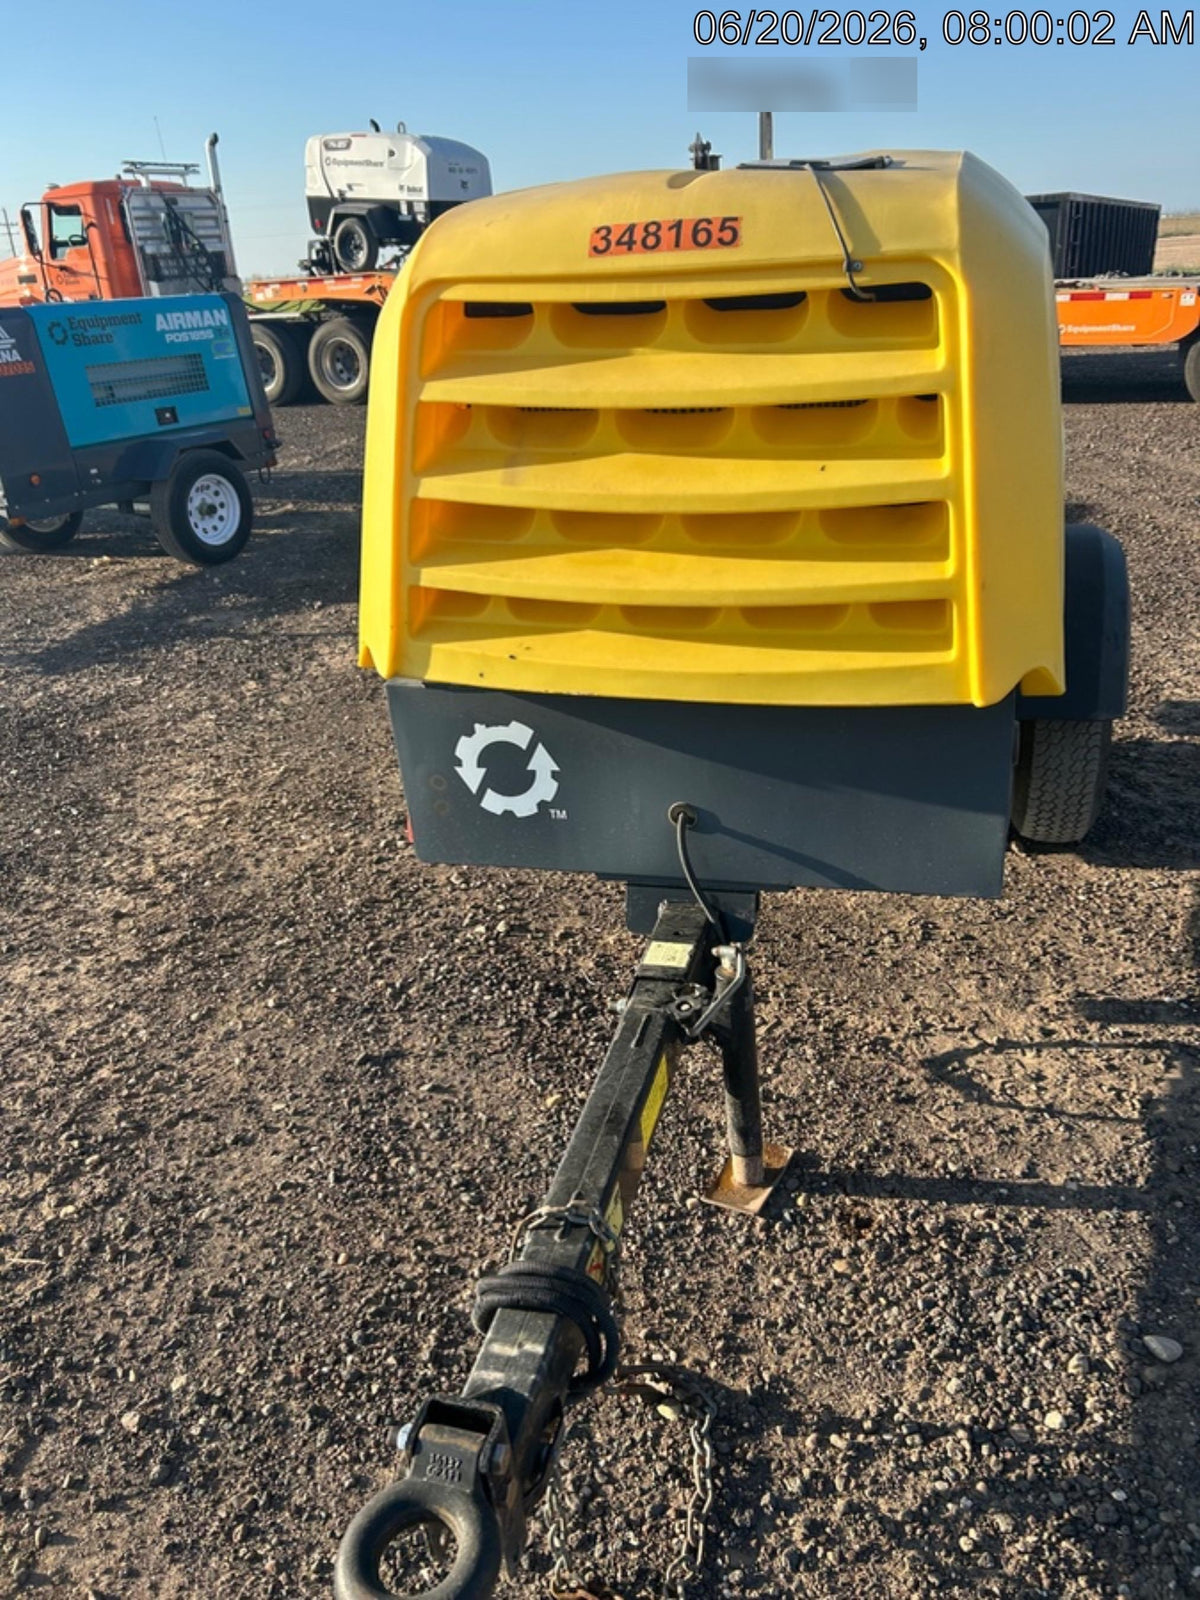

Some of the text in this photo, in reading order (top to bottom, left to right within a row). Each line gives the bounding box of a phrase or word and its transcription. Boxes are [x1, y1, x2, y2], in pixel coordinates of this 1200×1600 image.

[592, 216, 739, 254] 348165
[67, 312, 143, 333] Equipment
[155, 309, 228, 332] AIRMAN
[72, 332, 114, 348] Share
[549, 808, 568, 819] TM
